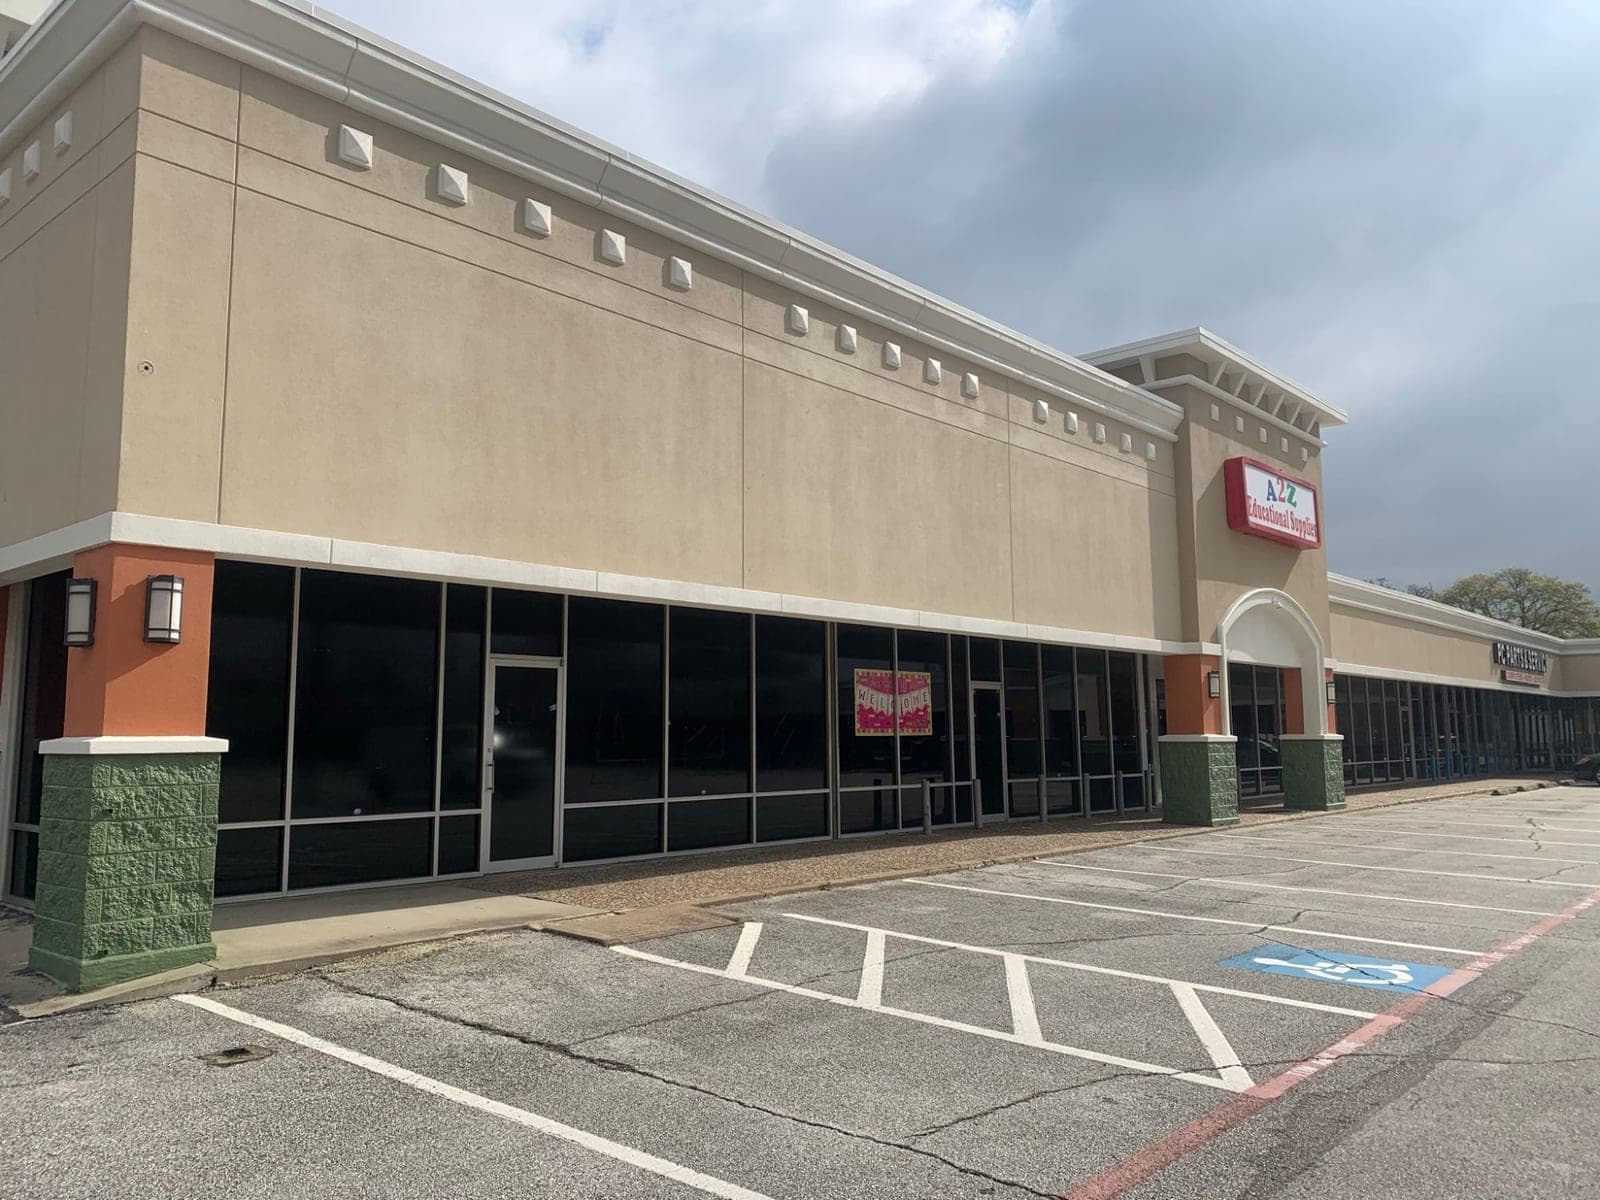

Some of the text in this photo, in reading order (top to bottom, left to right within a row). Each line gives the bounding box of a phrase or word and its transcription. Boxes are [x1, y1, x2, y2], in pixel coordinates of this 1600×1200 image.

[1266, 476, 1297, 508] A2Z
[1247, 495, 1290, 530] Educational
[1497, 642, 1506, 665] PC
